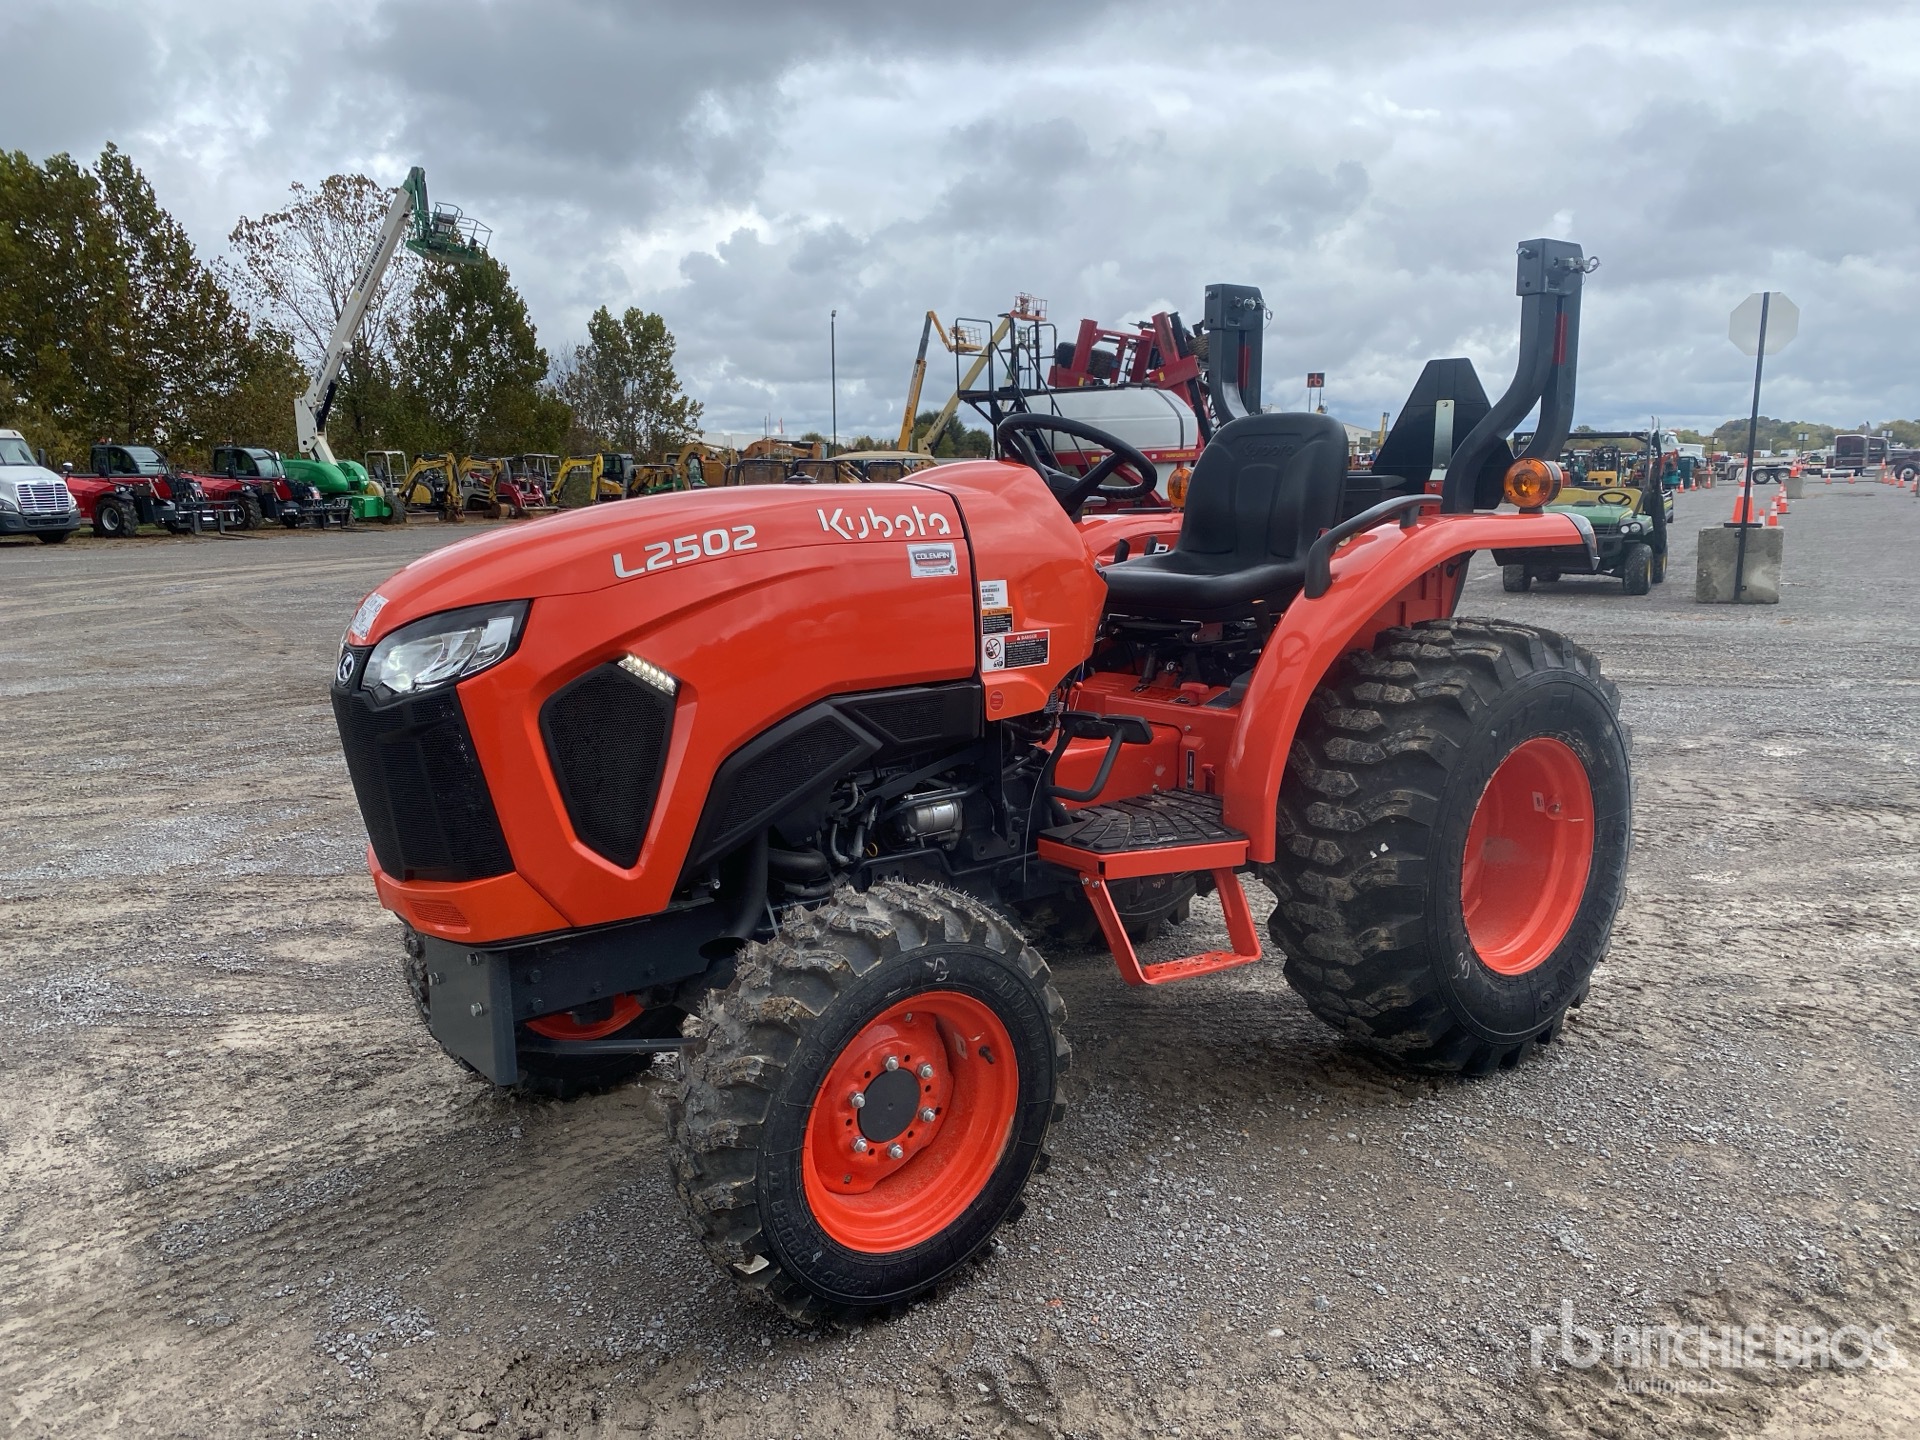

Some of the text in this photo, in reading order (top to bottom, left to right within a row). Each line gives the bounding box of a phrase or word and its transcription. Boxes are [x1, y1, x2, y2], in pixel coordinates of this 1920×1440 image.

[358, 234, 387, 293] SUNBELT RENTALS
[817, 505, 951, 540] Kubota
[612, 525, 758, 579] L2502
[915, 552, 950, 560] COLEMAN
